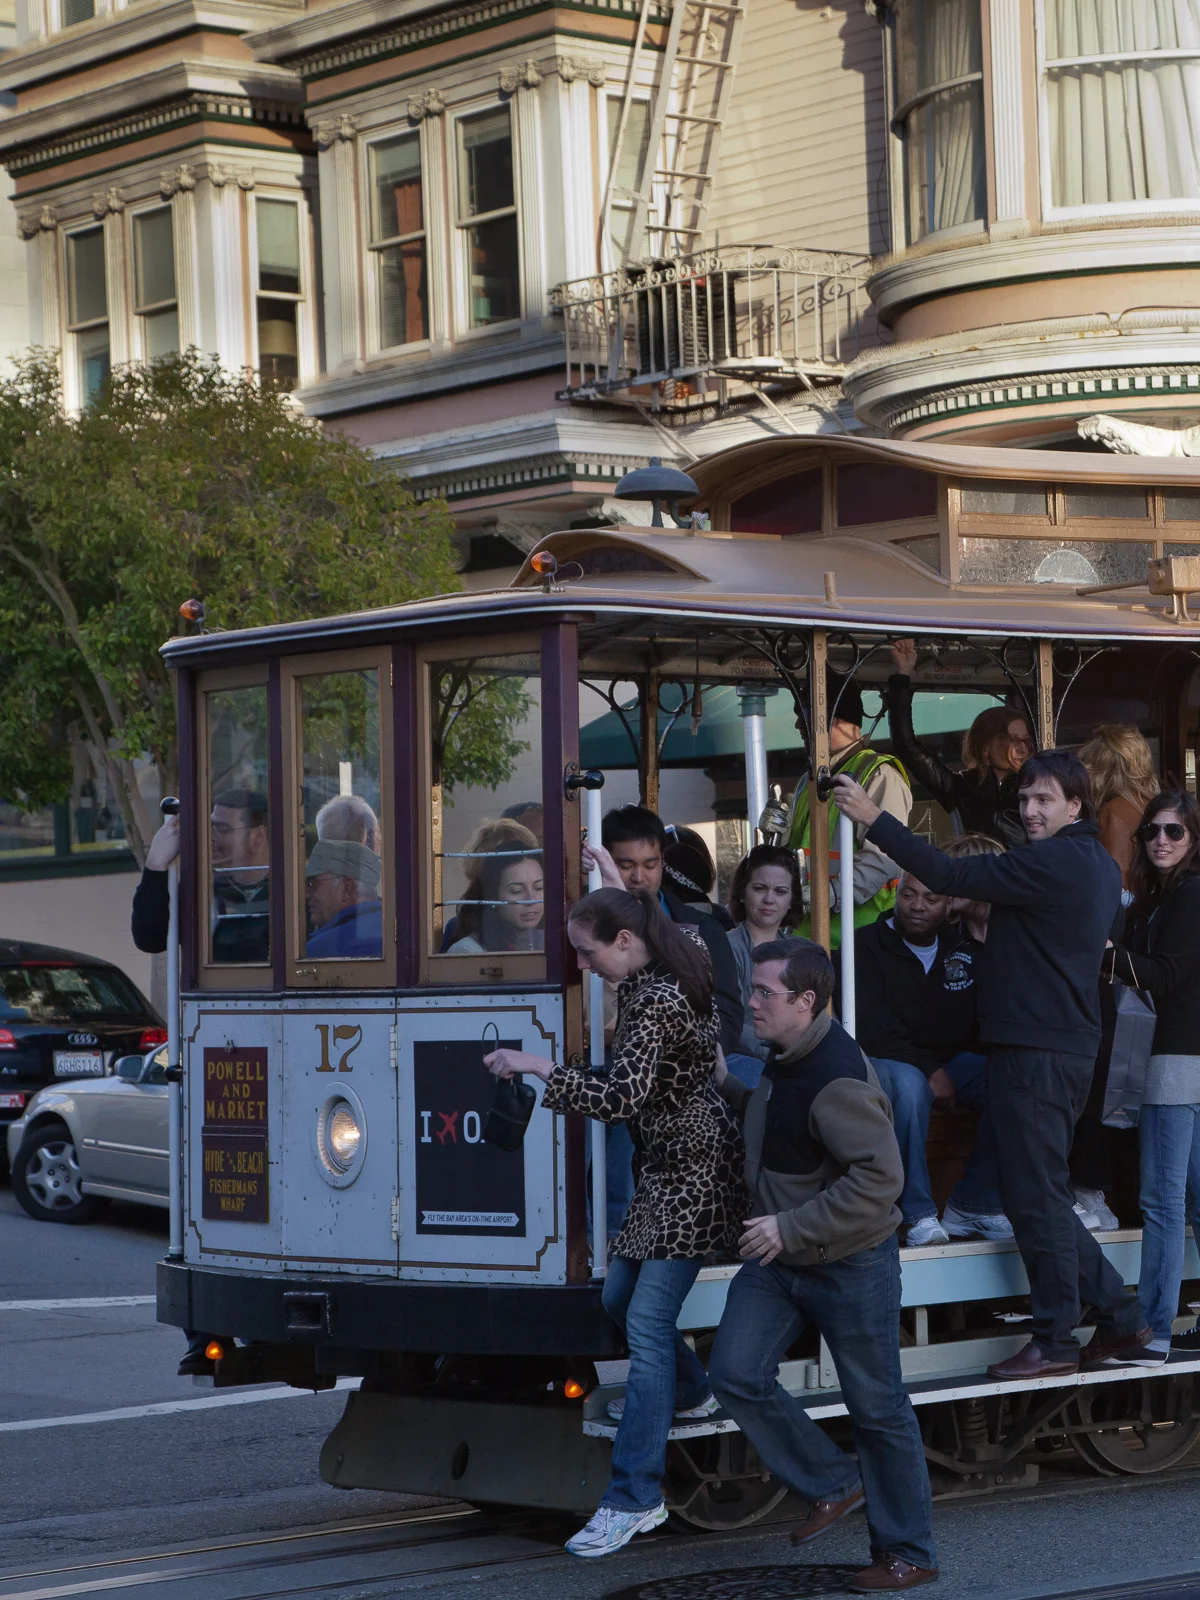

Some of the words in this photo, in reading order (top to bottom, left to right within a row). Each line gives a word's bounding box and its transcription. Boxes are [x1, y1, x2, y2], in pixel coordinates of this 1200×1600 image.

[819, 714, 825, 734] ON
[1046, 733, 1052, 749] ON
[314, 1024, 362, 1072] 17
[207, 1061, 264, 1081] POWELL
[222, 1083, 251, 1098] AND
[206, 1100, 266, 1120] MARKET
[421, 1111, 432, 1143] I
[205, 1151, 224, 1173] HYDE
[237, 1151, 264, 1174] BEACH
[209, 1178, 258, 1195] FISHERMANS
[220, 1197, 246, 1212] WHARF
[427, 1214, 436, 1222] FLY
[436, 1214, 446, 1222] THE
[446, 1214, 455, 1222] BAY
[472, 1215, 492, 1223] ON-TIME
